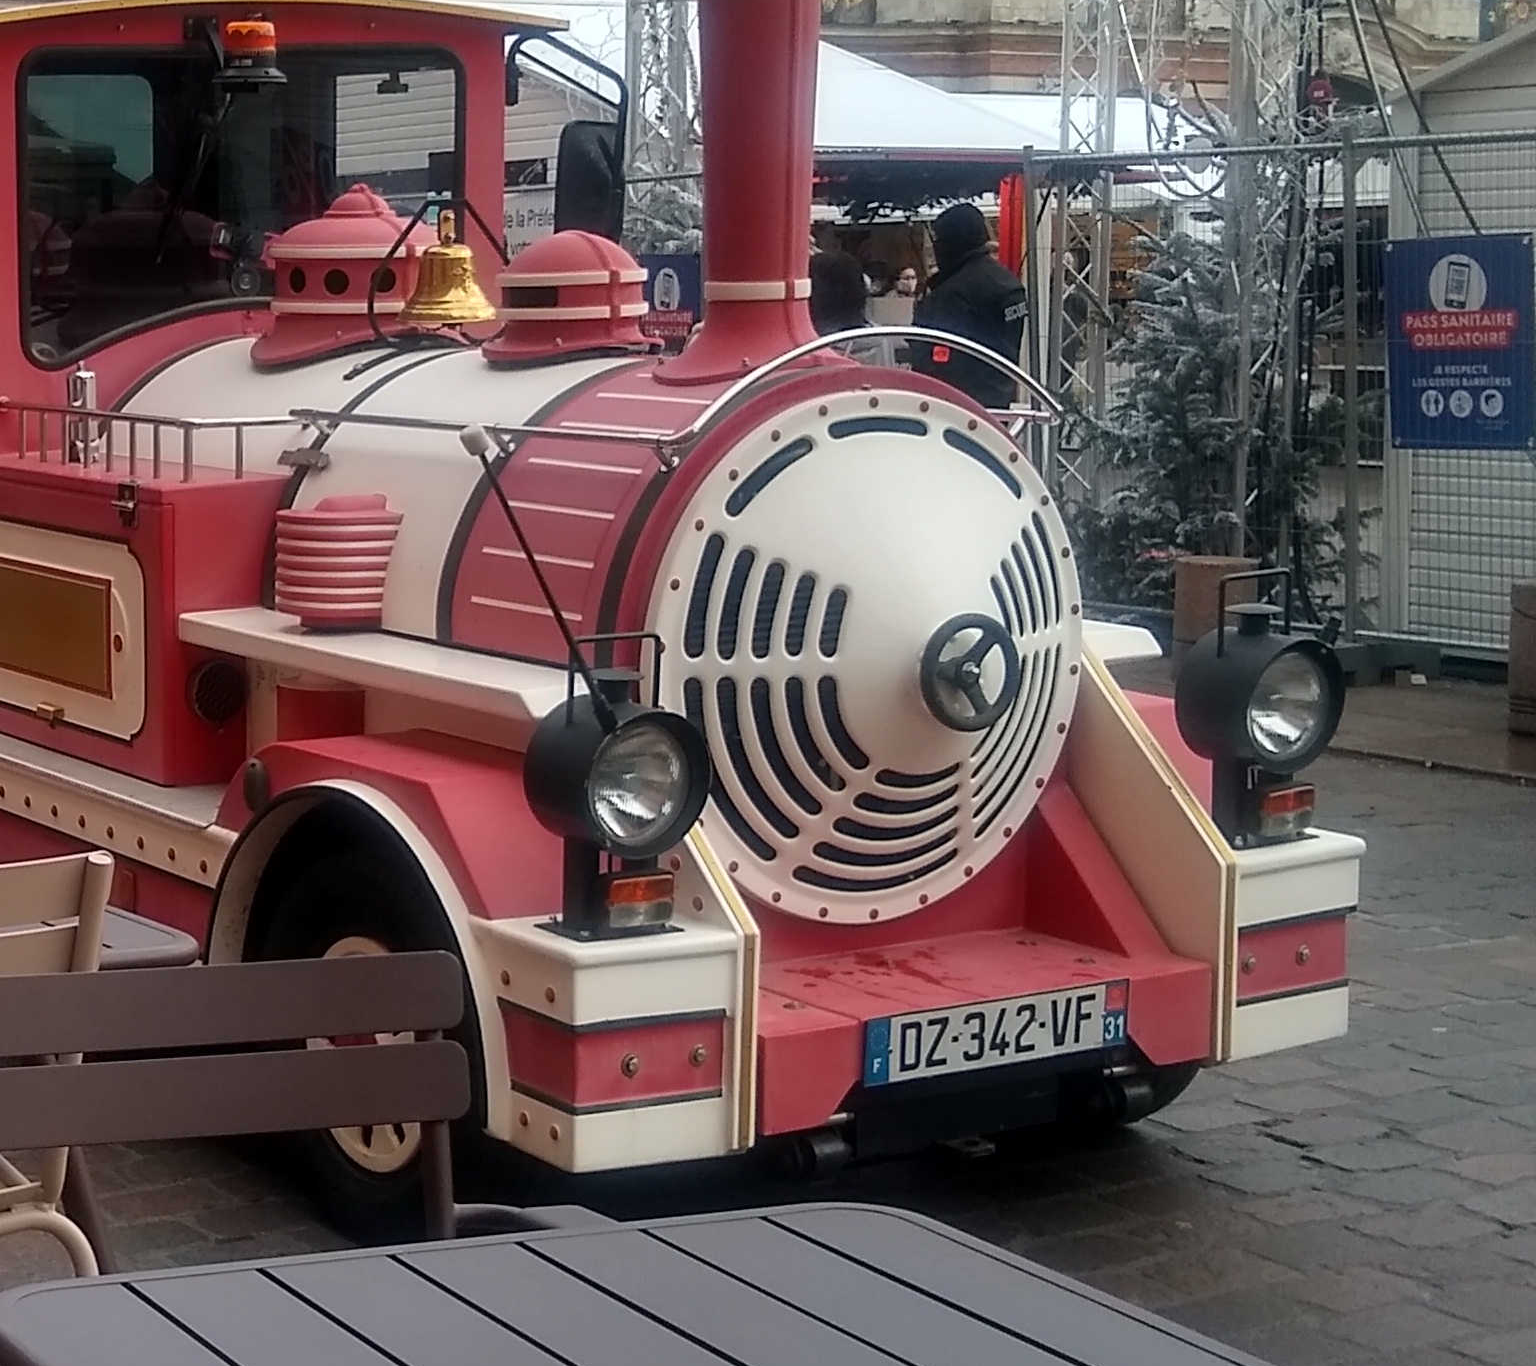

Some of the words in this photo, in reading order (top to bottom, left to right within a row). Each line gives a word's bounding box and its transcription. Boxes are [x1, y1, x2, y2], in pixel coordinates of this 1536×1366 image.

[1406, 315, 1438, 329] PASS
[1441, 312, 1513, 328] SANITAIRE
[1413, 331, 1508, 347] OBLIGATOIRE
[898, 993, 1096, 1073] DZ-342-VF
[1104, 1016, 1124, 1040] 31
[872, 1057, 882, 1074] F
